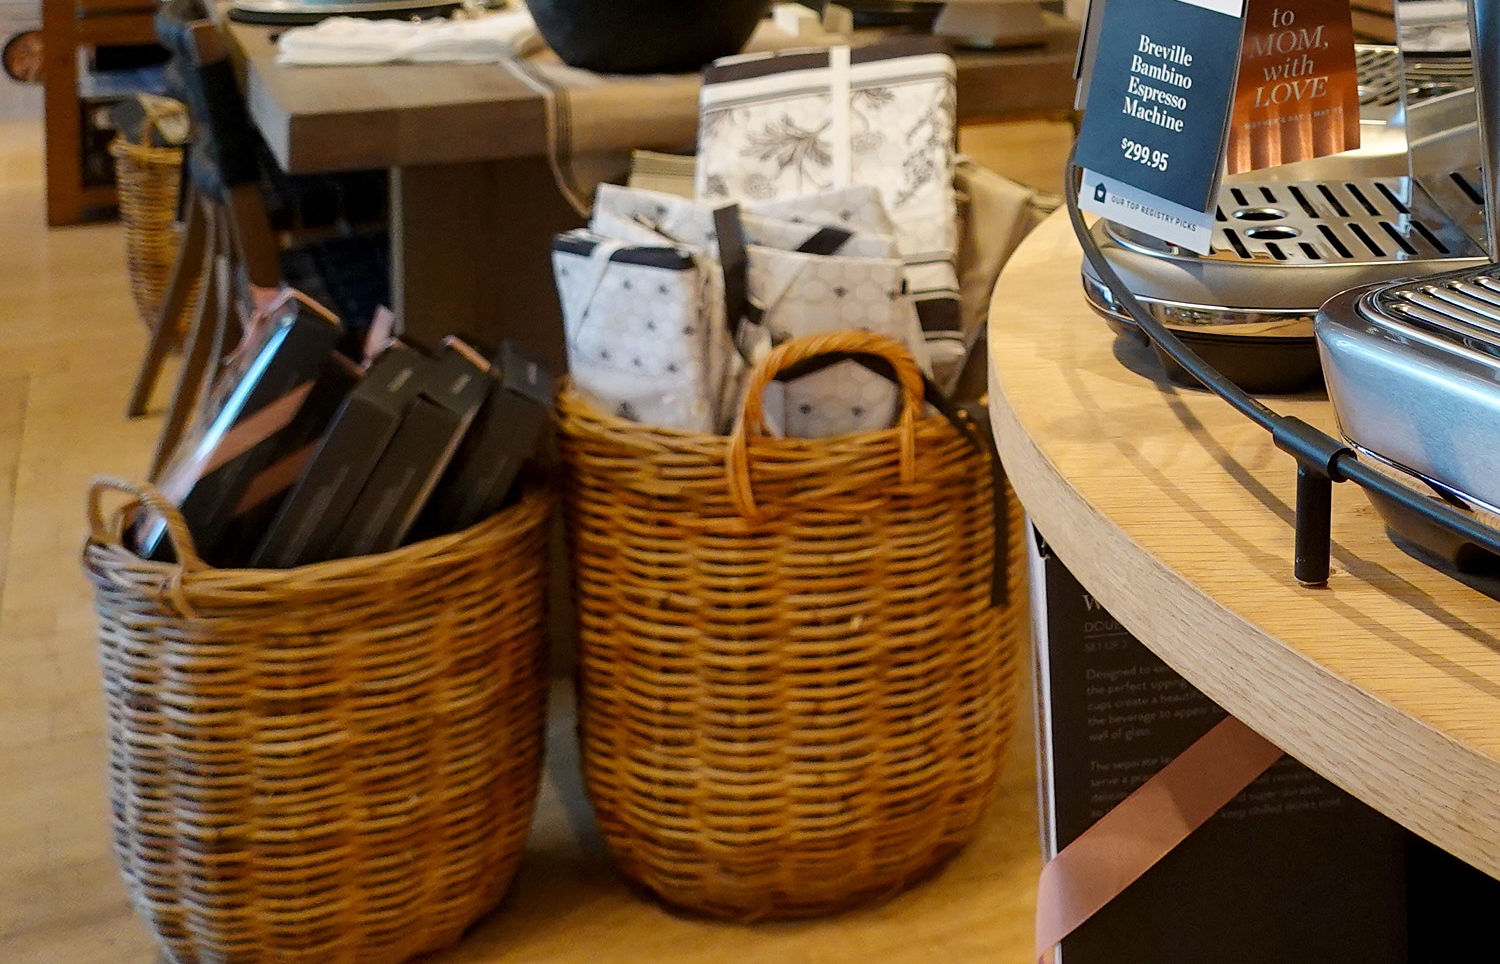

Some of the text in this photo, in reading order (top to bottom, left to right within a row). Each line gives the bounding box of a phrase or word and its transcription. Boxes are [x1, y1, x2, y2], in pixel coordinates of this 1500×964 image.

[1272, 7, 1295, 28] to
[1138, 34, 1193, 67] Breville
[1248, 25, 1329, 58] MOM,
[1131, 54, 1192, 90] Bambino
[1263, 54, 1314, 81] with
[1128, 75, 1187, 111] Espresso
[1255, 76, 1329, 108] LOVE
[1122, 96, 1184, 133] Machine
[1121, 137, 1169, 172] $299.95
[1111, 196, 1197, 232] OUR TOP REGISTRY PICKS
